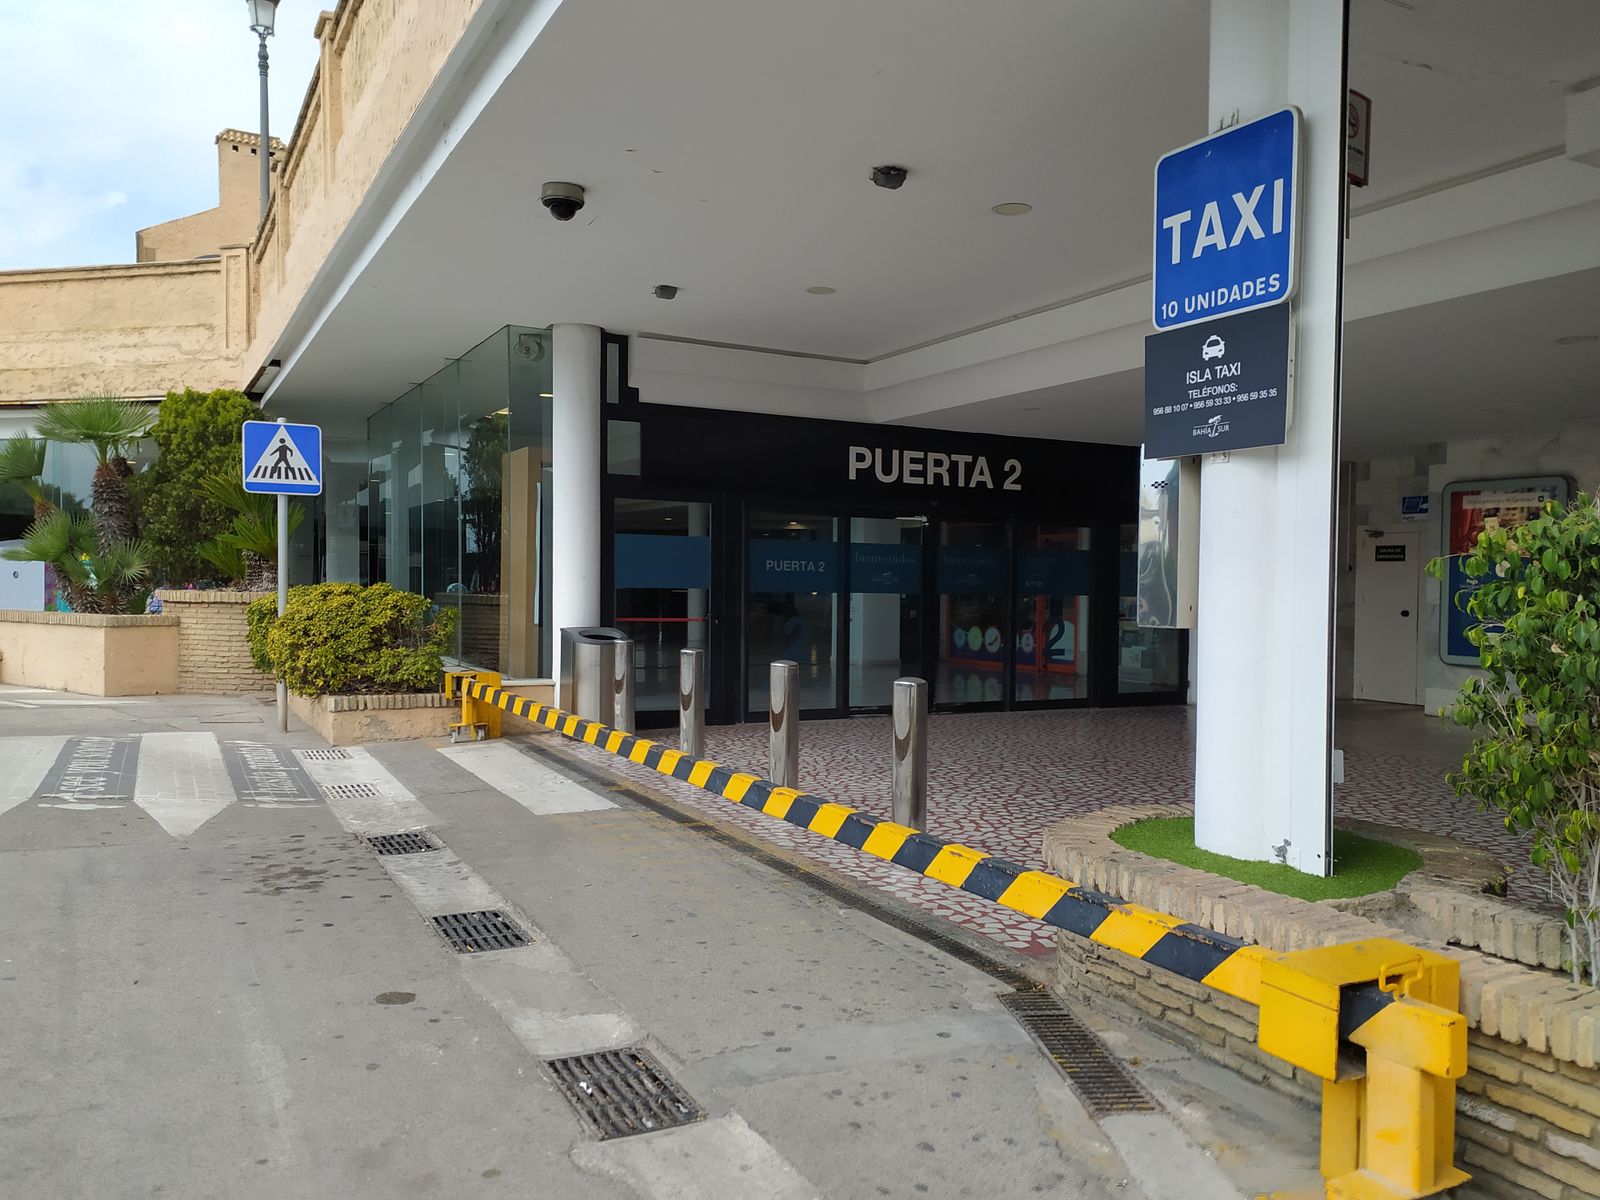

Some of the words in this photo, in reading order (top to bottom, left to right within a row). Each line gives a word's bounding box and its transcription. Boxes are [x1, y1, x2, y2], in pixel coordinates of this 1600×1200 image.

[1162, 177, 1285, 266] TAXI
[1161, 300, 1178, 320] 10
[1185, 272, 1281, 315] UNIDADES
[1186, 368, 1212, 385] ISLA
[1214, 362, 1241, 379] TAXI
[1152, 407, 1164, 416] 956
[1173, 404, 1180, 413] 10
[1181, 403, 1189, 412] 07
[1193, 400, 1205, 410] 956
[1205, 398, 1214, 407] 59
[1214, 397, 1222, 406] 33
[1223, 396, 1231, 405] 33
[1236, 394, 1249, 403] 956
[1250, 391, 1258, 401] 59
[1259, 389, 1268, 399] 35
[1268, 388, 1278, 398] 35
[1188, 382, 1239, 399] TELÉFONOS:
[1217, 424, 1230, 433] SUR
[848, 445, 994, 489] PUERTA
[1003, 458, 1022, 491] 2
[766, 559, 815, 572] PUERTA
[818, 561, 826, 572] 2
[855, 551, 917, 564] bienvenidos
